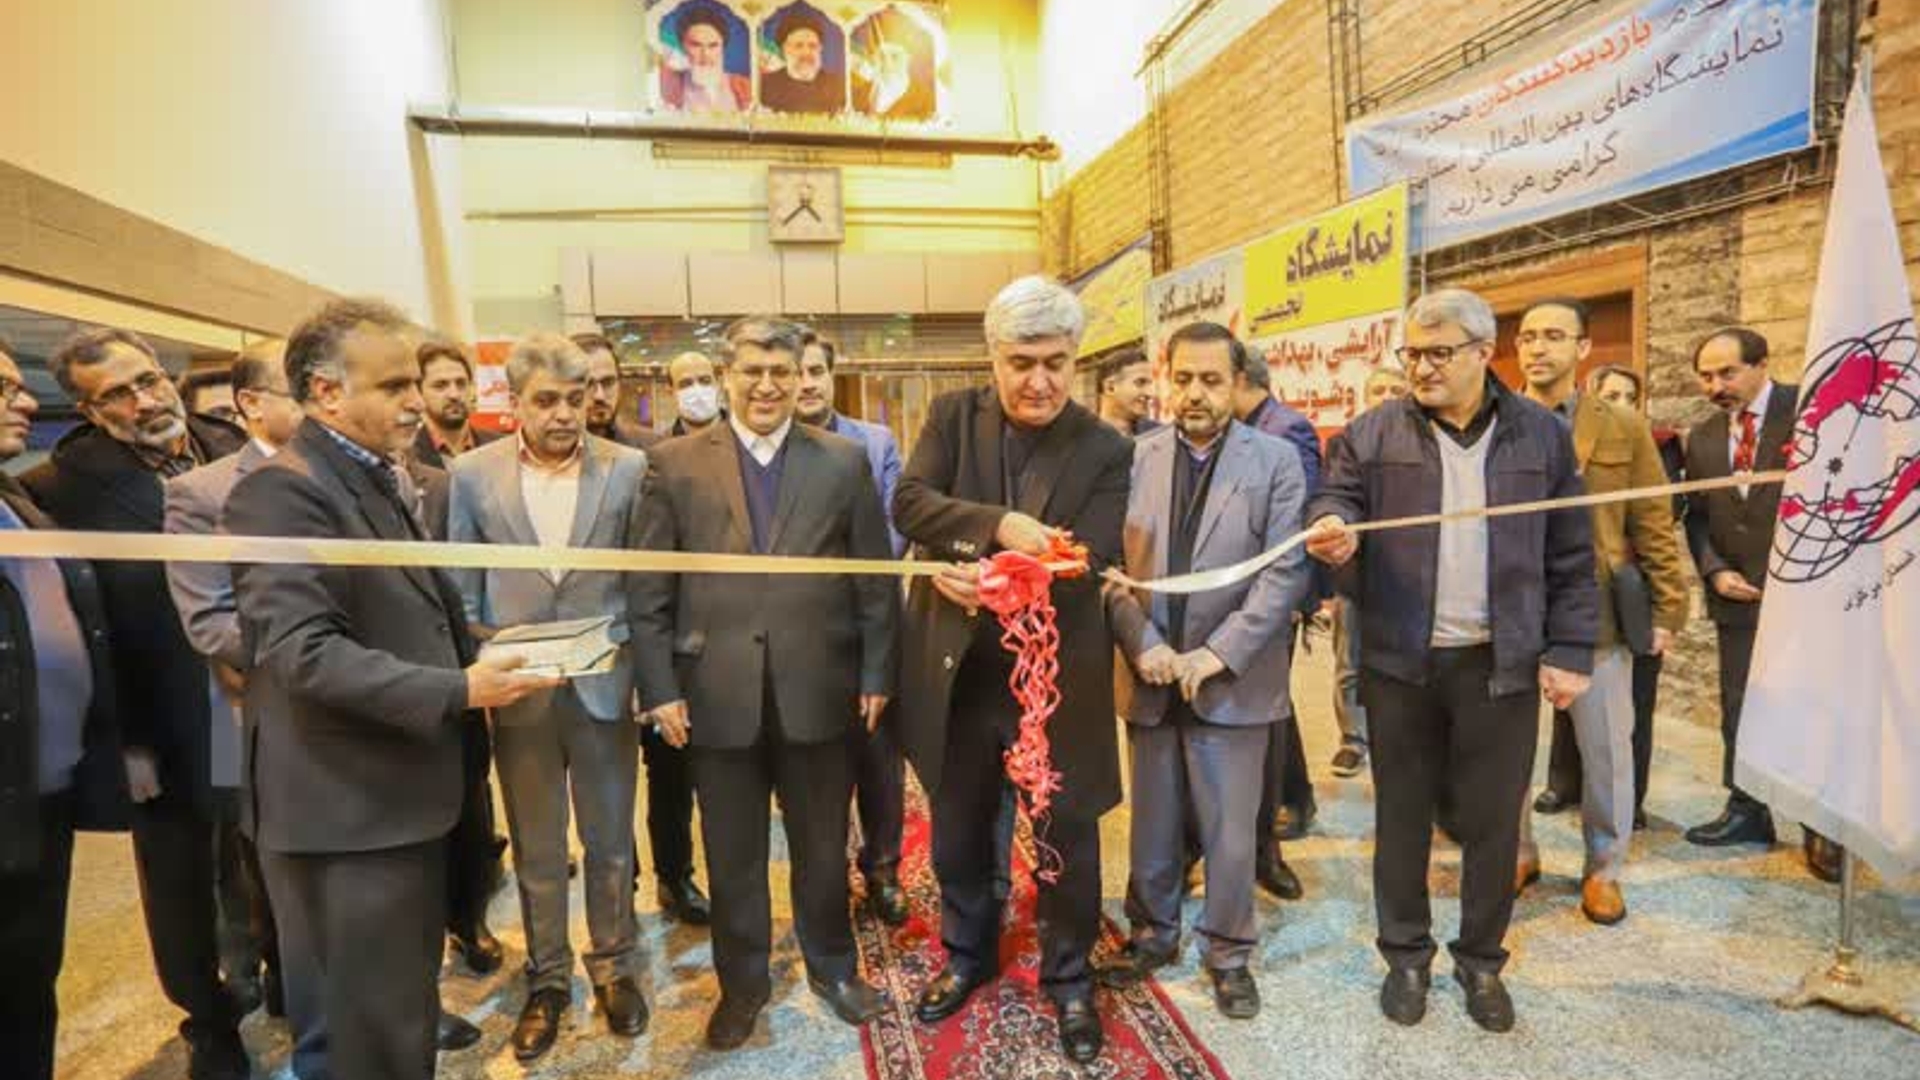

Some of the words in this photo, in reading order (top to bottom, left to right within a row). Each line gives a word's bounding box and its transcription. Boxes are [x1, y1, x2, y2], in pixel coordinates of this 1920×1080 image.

[1541, 110, 1585, 142] بین
[1540, 130, 1619, 193] گرامی
[1499, 174, 1535, 206] می
[1286, 210, 1393, 284] نمایشگاه
[1157, 271, 1227, 323] نمایشگاه
